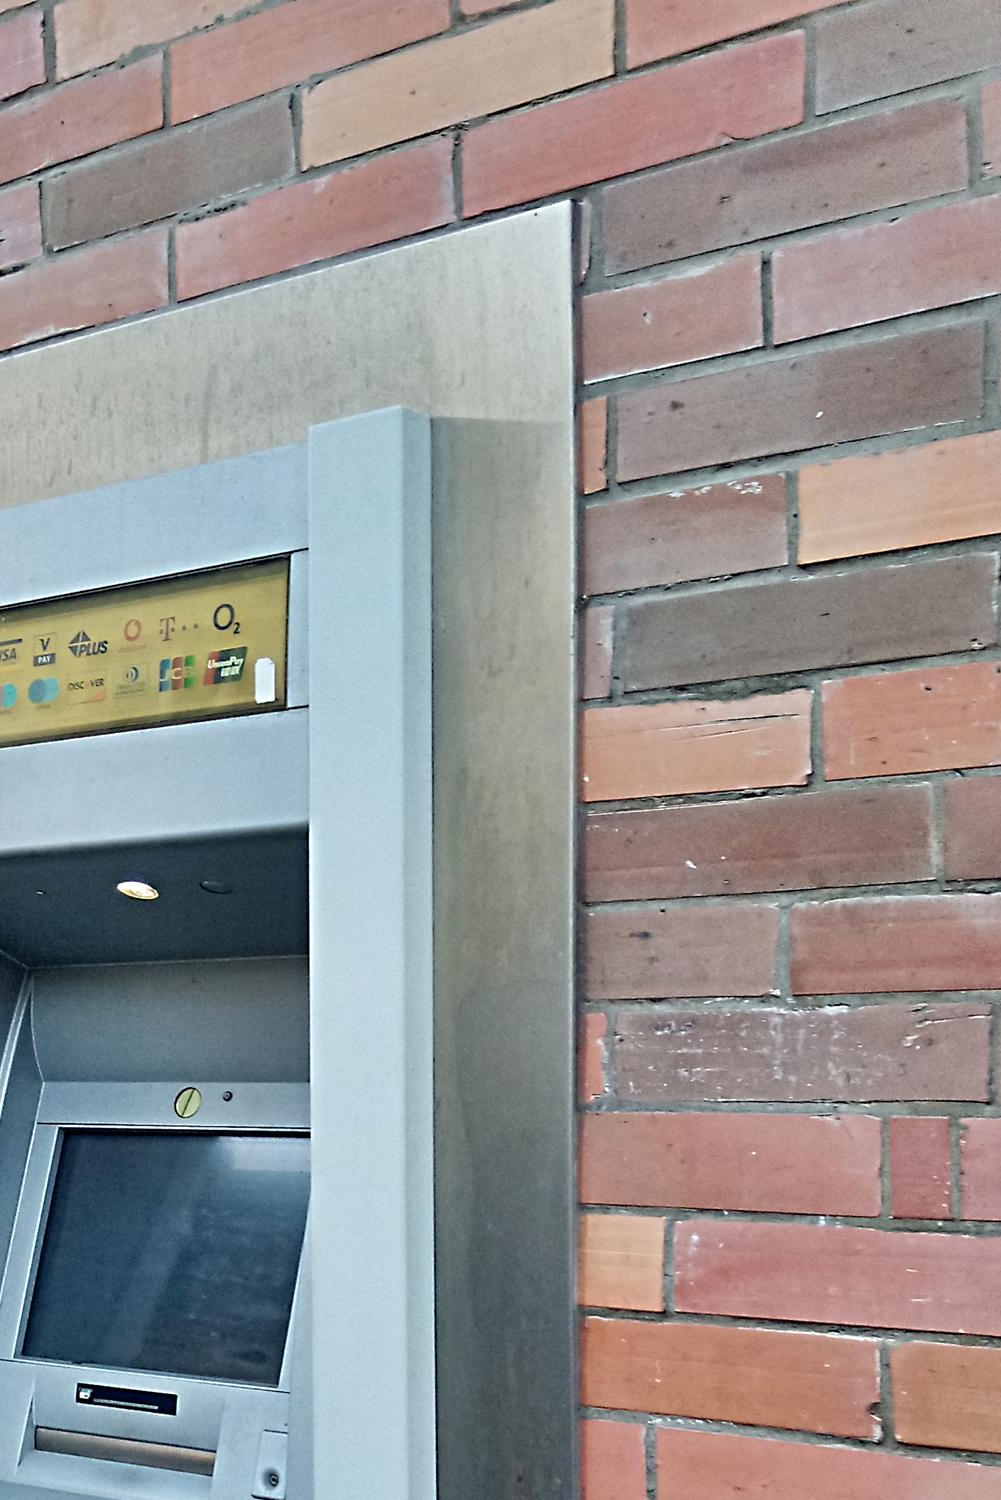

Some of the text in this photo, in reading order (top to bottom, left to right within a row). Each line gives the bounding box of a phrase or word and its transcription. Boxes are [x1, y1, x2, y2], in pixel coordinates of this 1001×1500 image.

[213, 603, 241, 635] O2
[40, 637, 51, 652] V
[77, 640, 109, 657] PLUS
[37, 655, 52, 664] PAY
